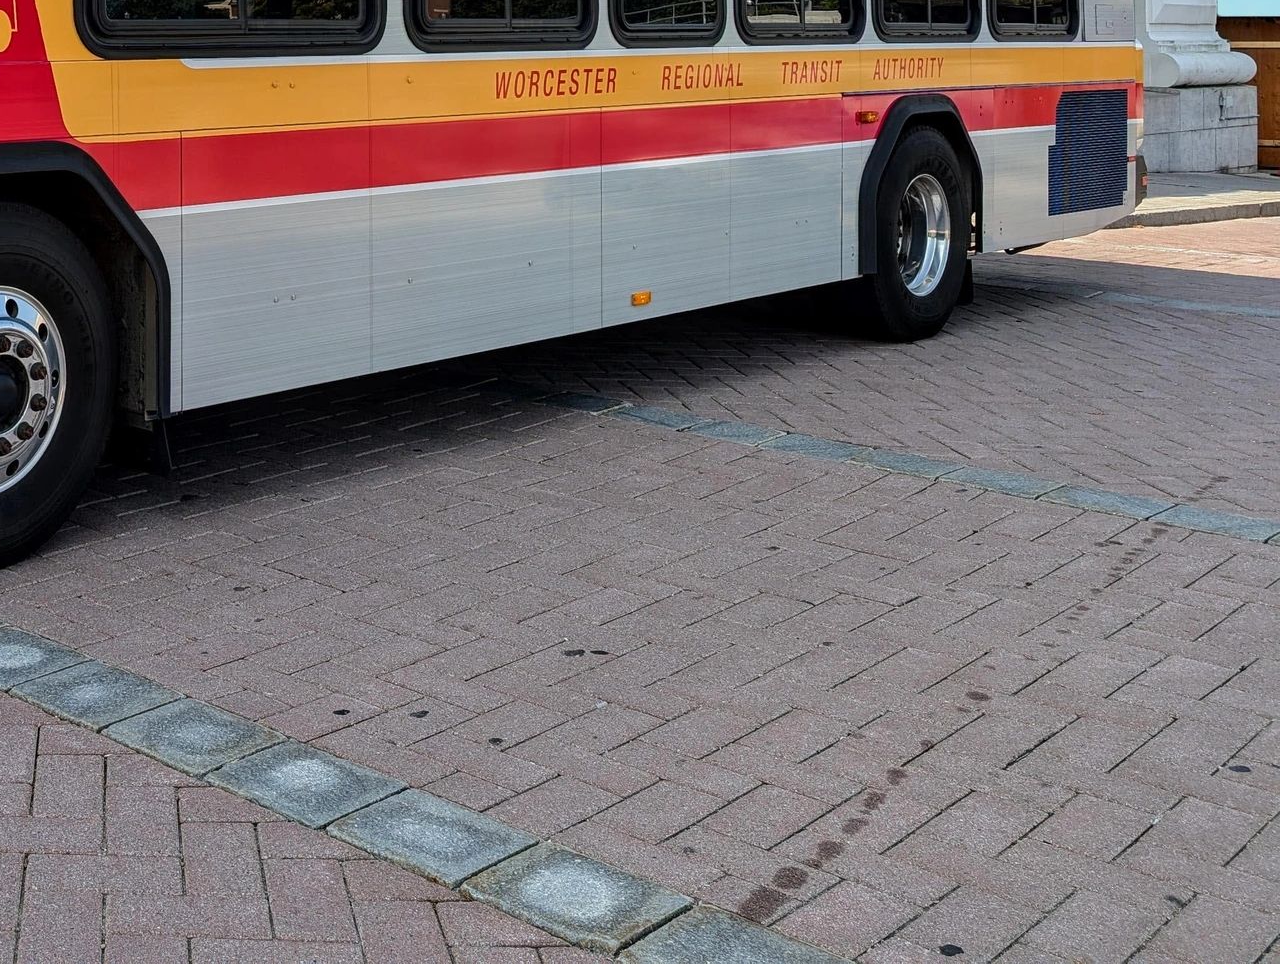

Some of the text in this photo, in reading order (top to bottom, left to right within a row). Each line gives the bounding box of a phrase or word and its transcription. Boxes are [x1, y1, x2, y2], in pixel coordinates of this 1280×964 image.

[495, 56, 945, 100] WORCESTER REGIONAL TRANSIT AUTHORITY
